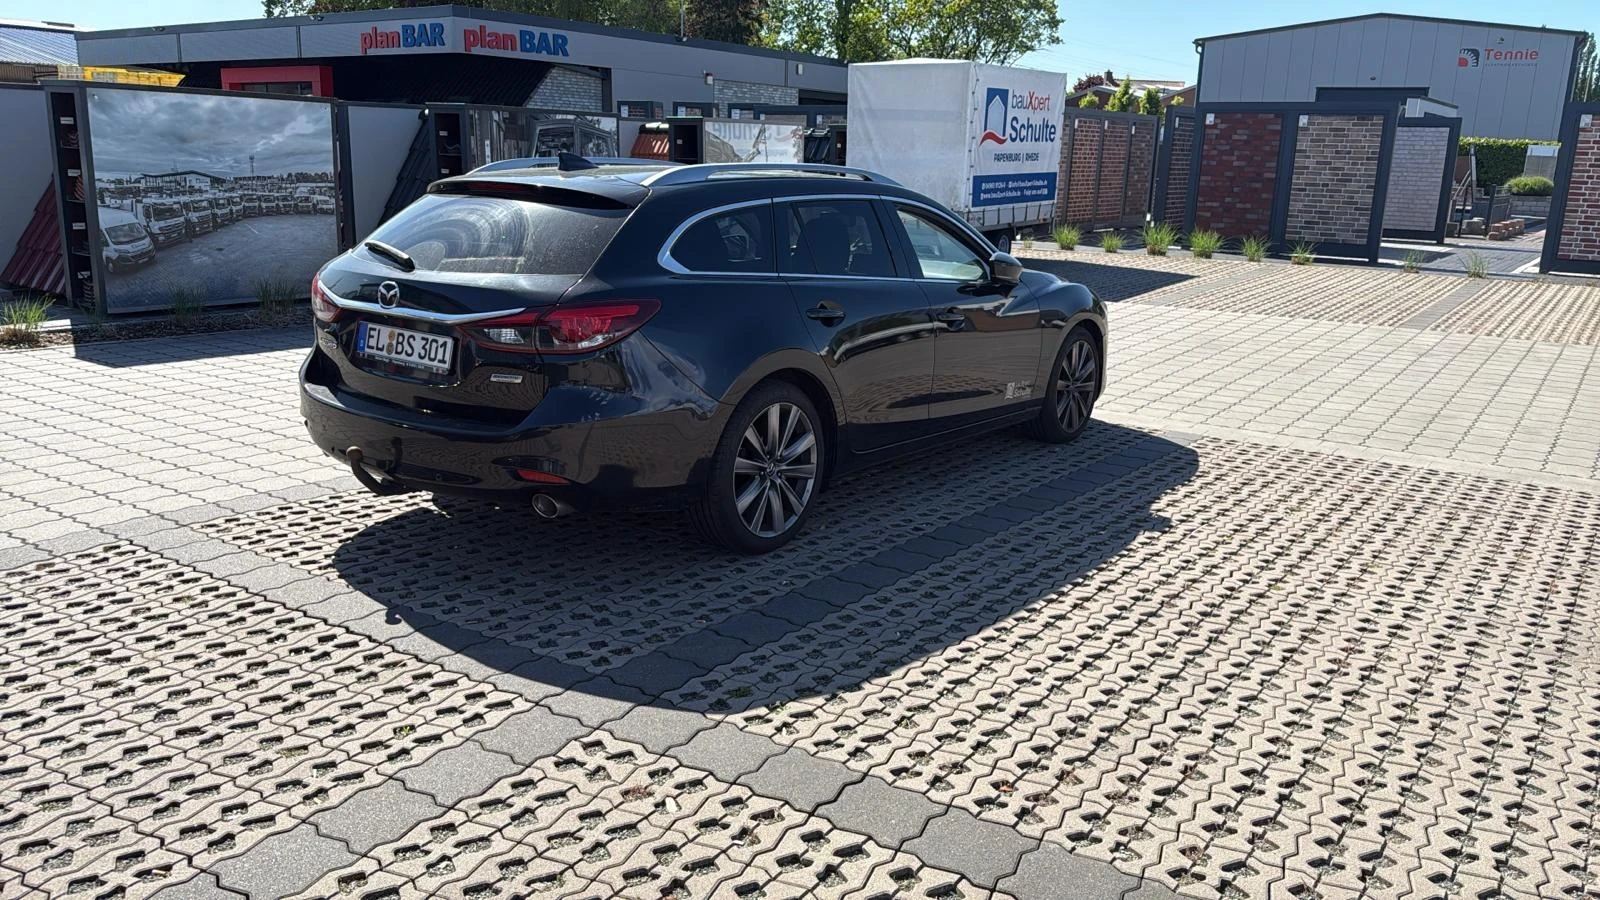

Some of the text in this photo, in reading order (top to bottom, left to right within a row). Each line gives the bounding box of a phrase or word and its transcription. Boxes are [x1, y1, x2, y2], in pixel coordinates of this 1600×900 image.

[361, 23, 445, 54] planBAR
[463, 25, 569, 57] planBAR
[1484, 48, 1539, 60] Tennie
[1011, 89, 1051, 114] bauXpert
[1009, 116, 1057, 143] Schulte
[366, 327, 385, 351] EL
[395, 332, 416, 357] BS
[418, 336, 448, 364] 301
